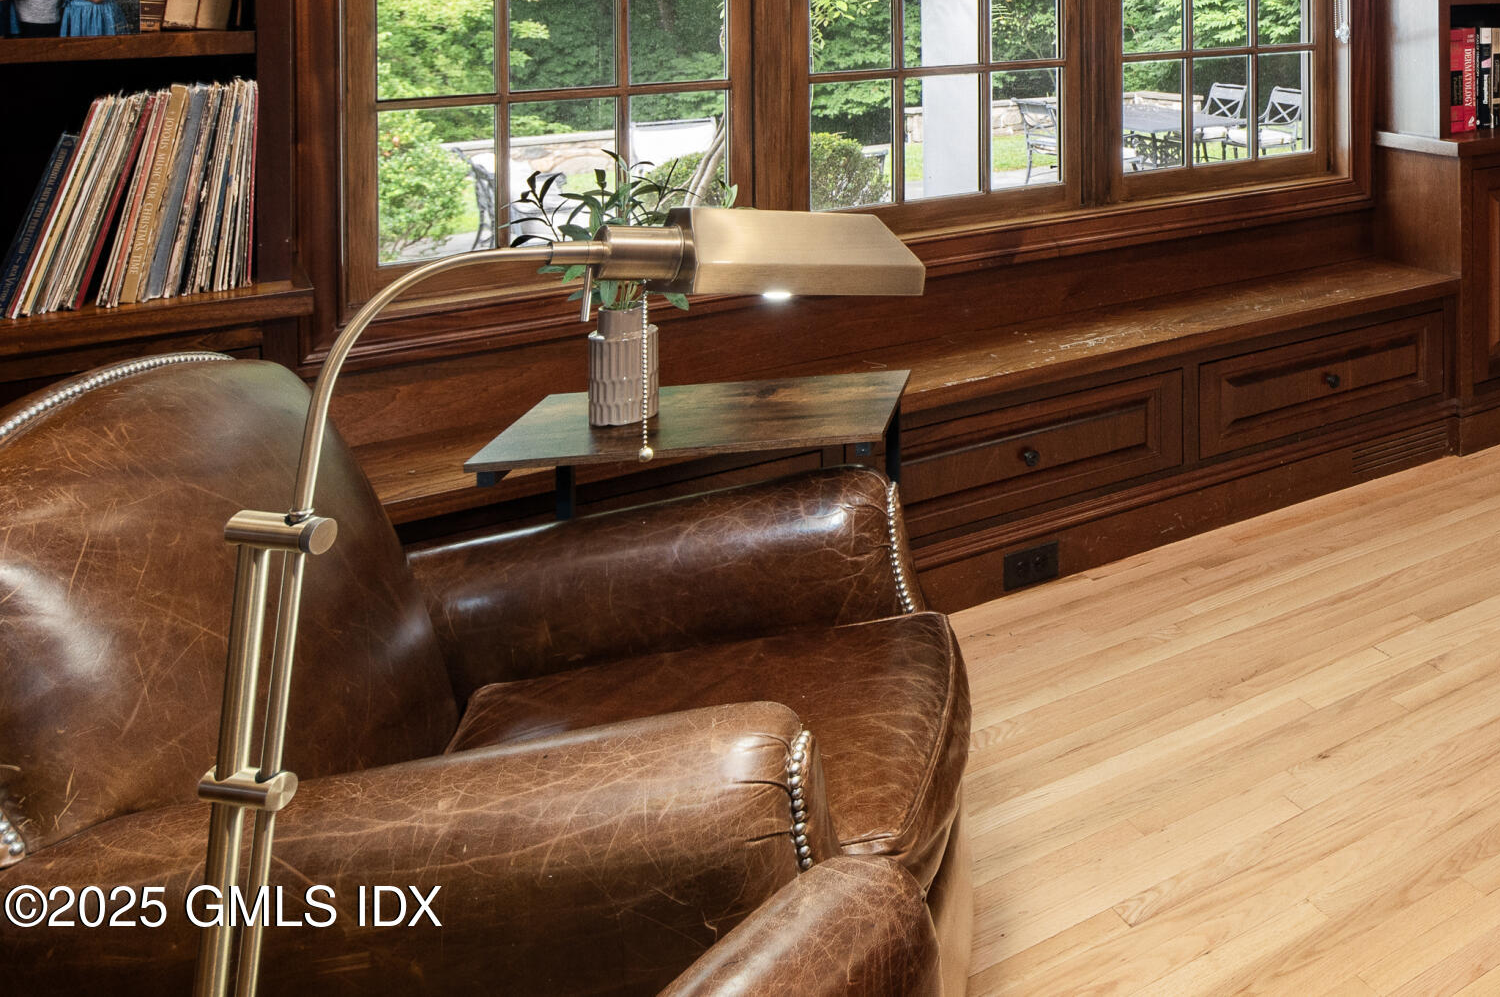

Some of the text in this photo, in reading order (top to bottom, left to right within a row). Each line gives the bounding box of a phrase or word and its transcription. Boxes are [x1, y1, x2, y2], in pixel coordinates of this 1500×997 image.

[1464, 48, 1472, 107] DERMATOLOGY
[130, 116, 175, 275] JOYOUS MUSIC FOR CHRISTMAS TIME
